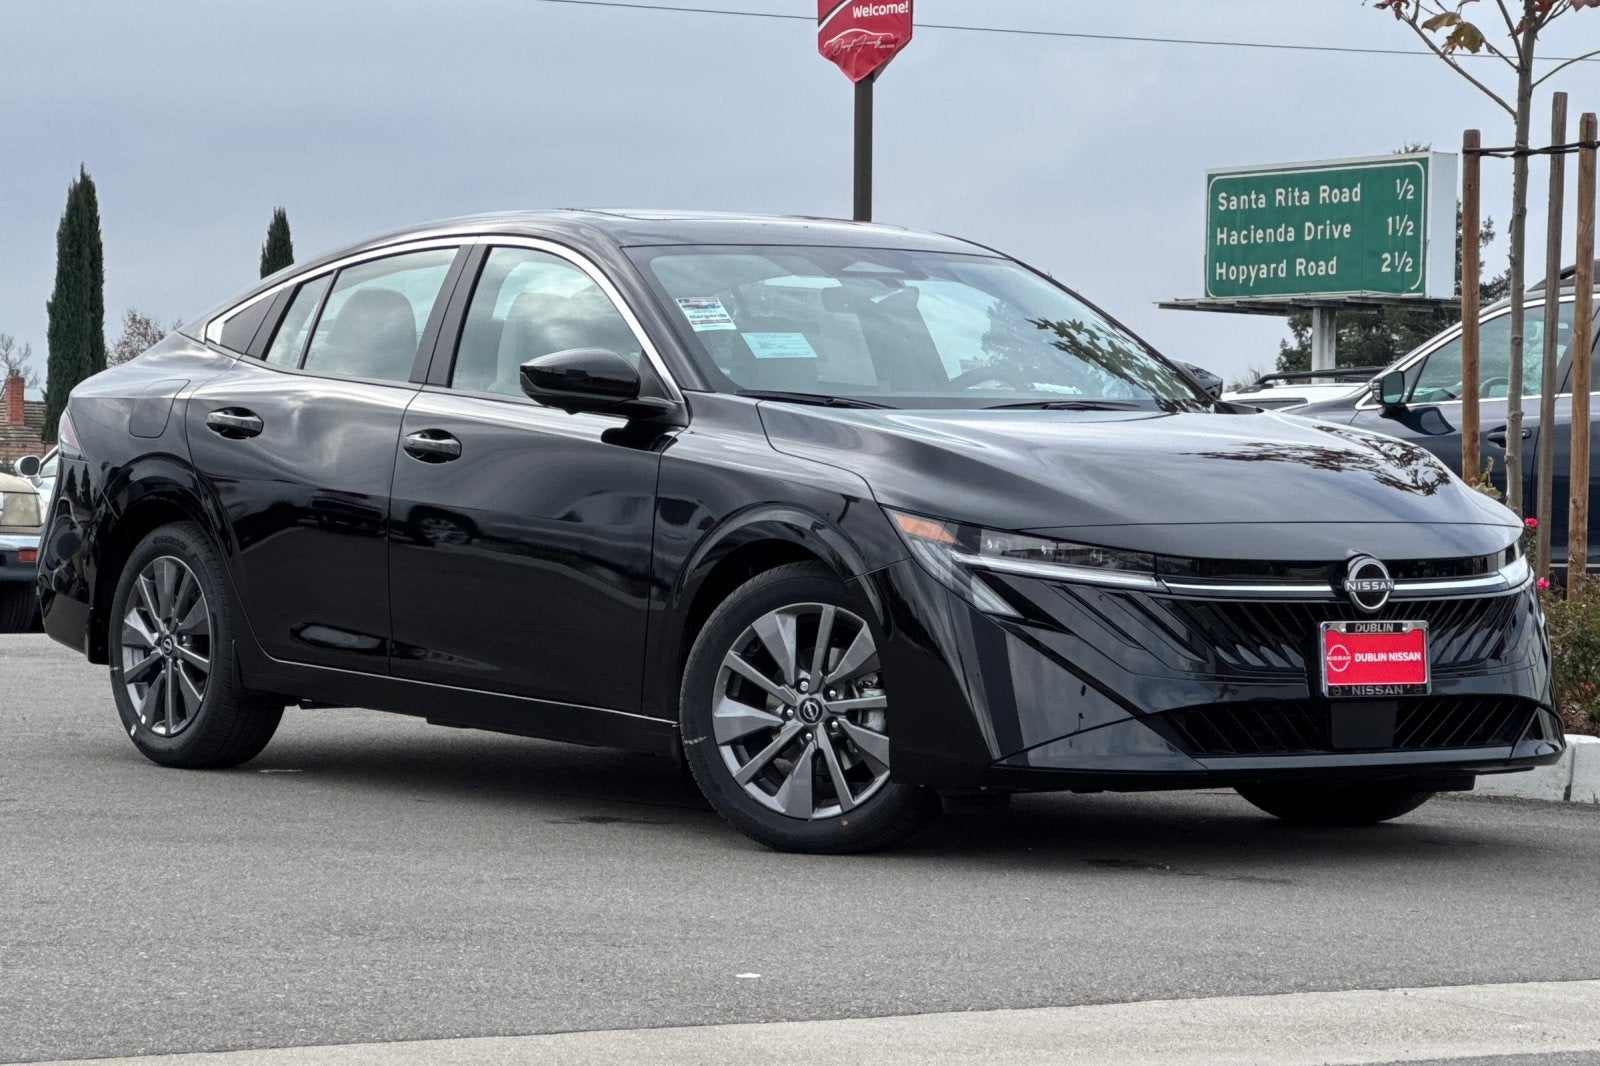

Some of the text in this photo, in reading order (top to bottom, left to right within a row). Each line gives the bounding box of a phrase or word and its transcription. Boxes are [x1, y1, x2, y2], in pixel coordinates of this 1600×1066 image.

[852, 1, 909, 18] Welcome!
[1217, 182, 1361, 211] Santa Rita Road
[1216, 220, 1352, 246] Hacienda Drive
[1215, 256, 1337, 286] Hopyard Road
[1346, 582, 1394, 590] NISSAN
[1355, 623, 1394, 633] DUBLIN
[1354, 652, 1421, 662] DUBLIN NISSAN
[1351, 685, 1404, 695] NISSAN
